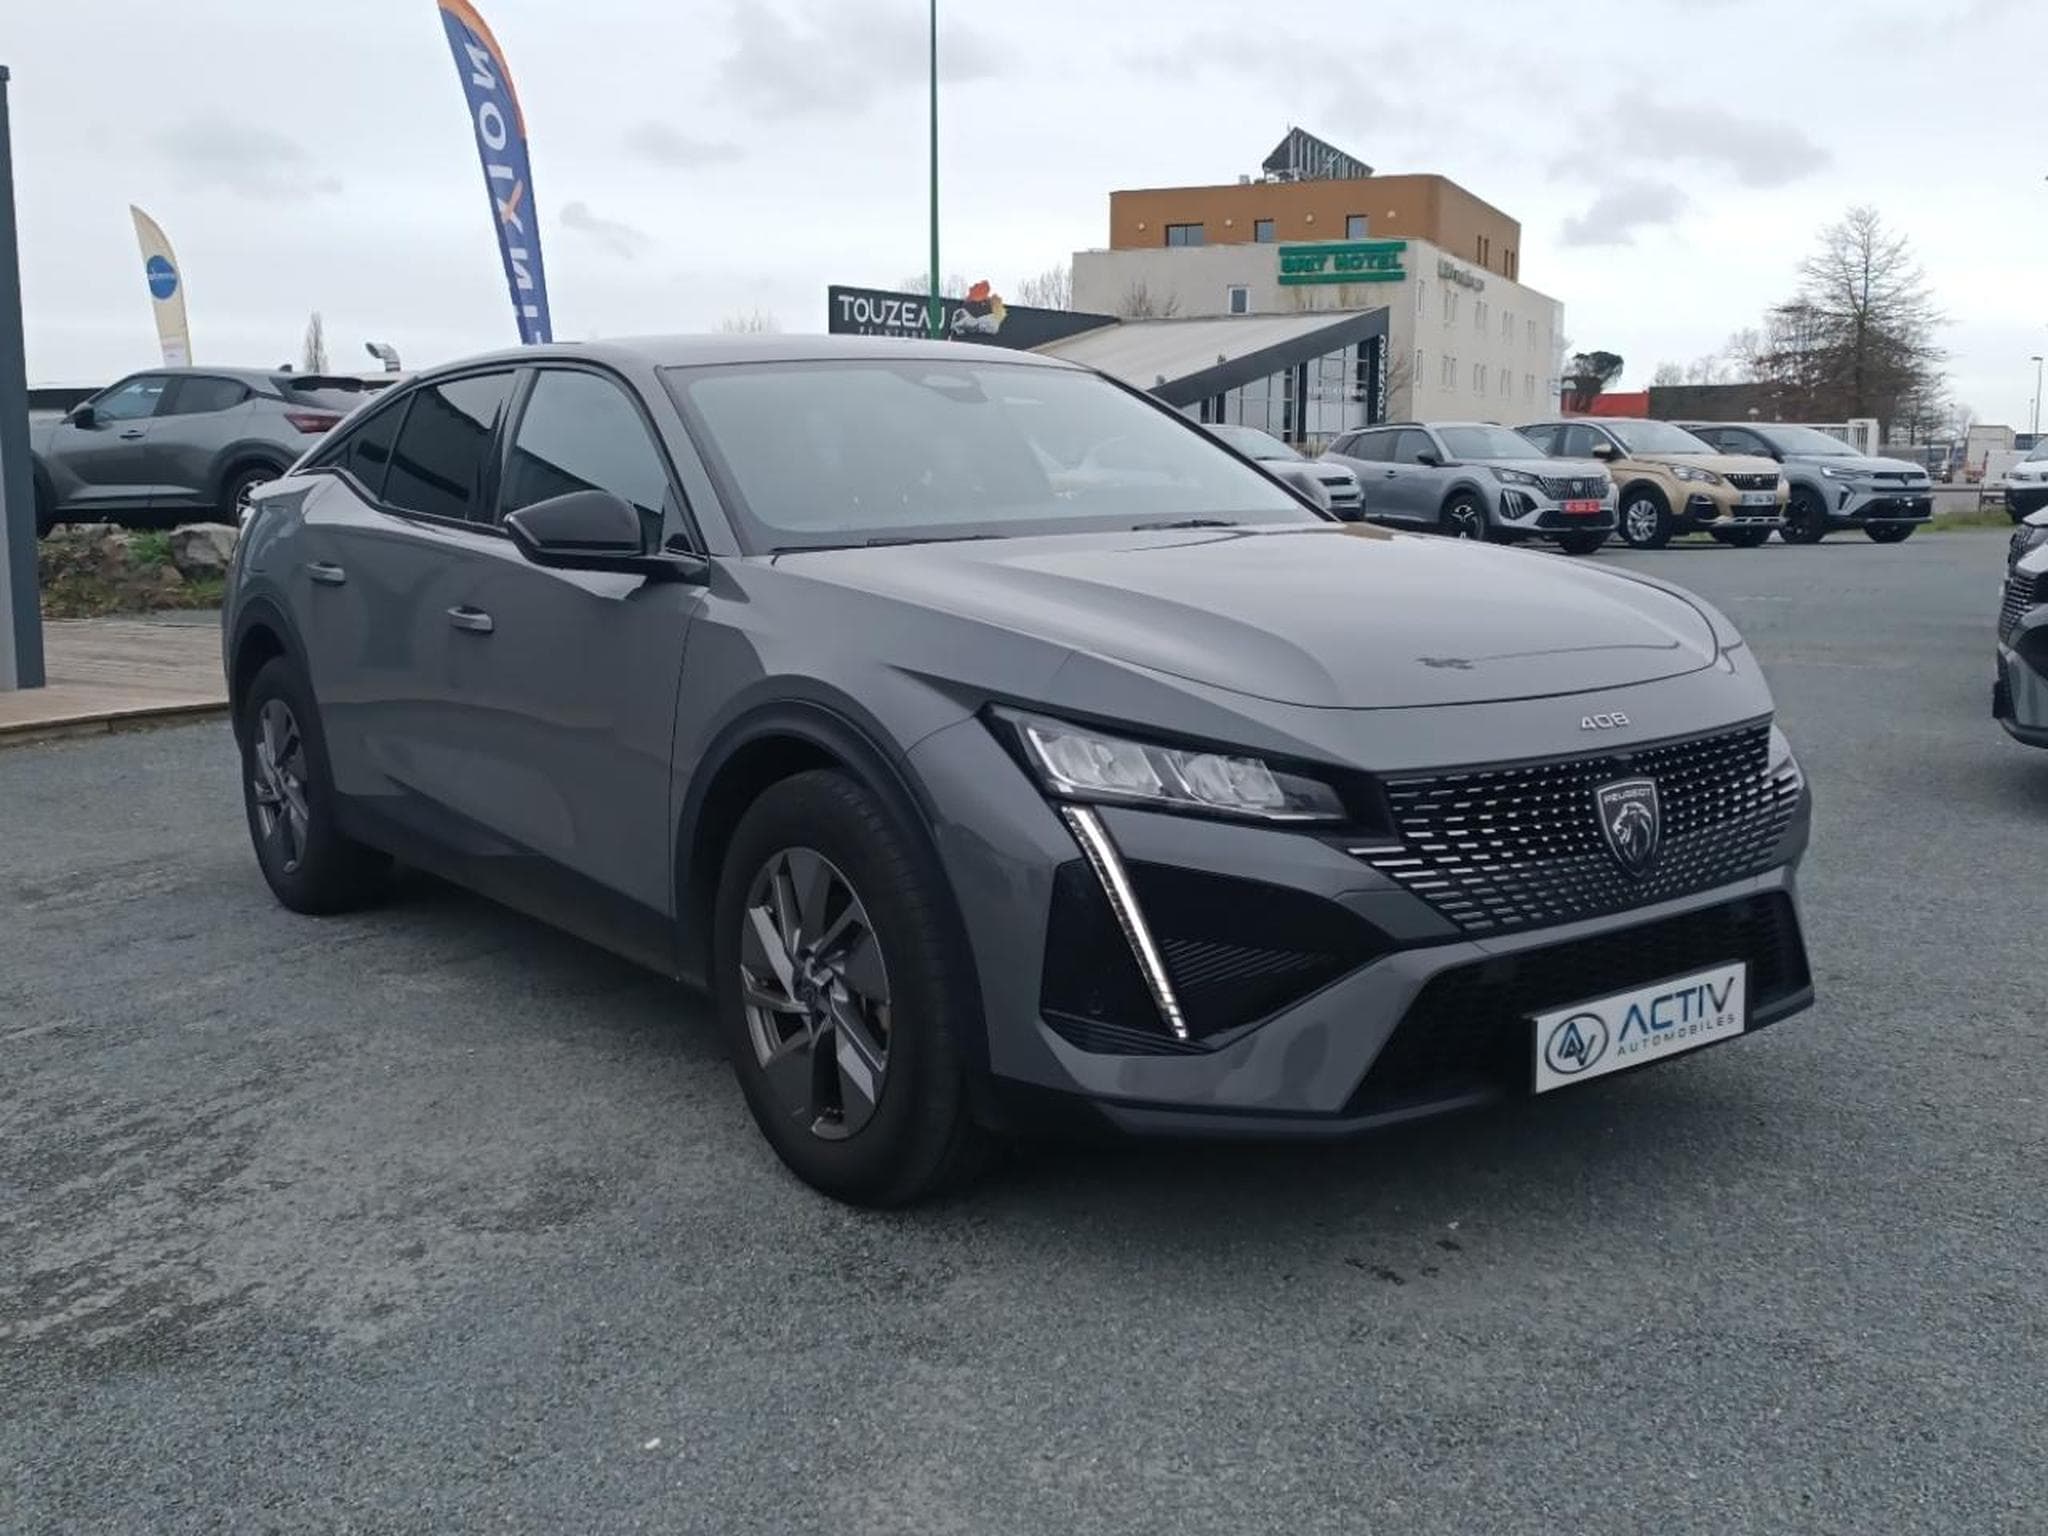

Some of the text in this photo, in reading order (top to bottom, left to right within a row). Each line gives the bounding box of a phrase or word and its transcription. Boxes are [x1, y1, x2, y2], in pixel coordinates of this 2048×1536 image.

[1581, 712, 1630, 730] 408
[1618, 976, 1735, 1042] ACTIV
[1617, 1013, 1735, 1057] AUTOMOBILES
